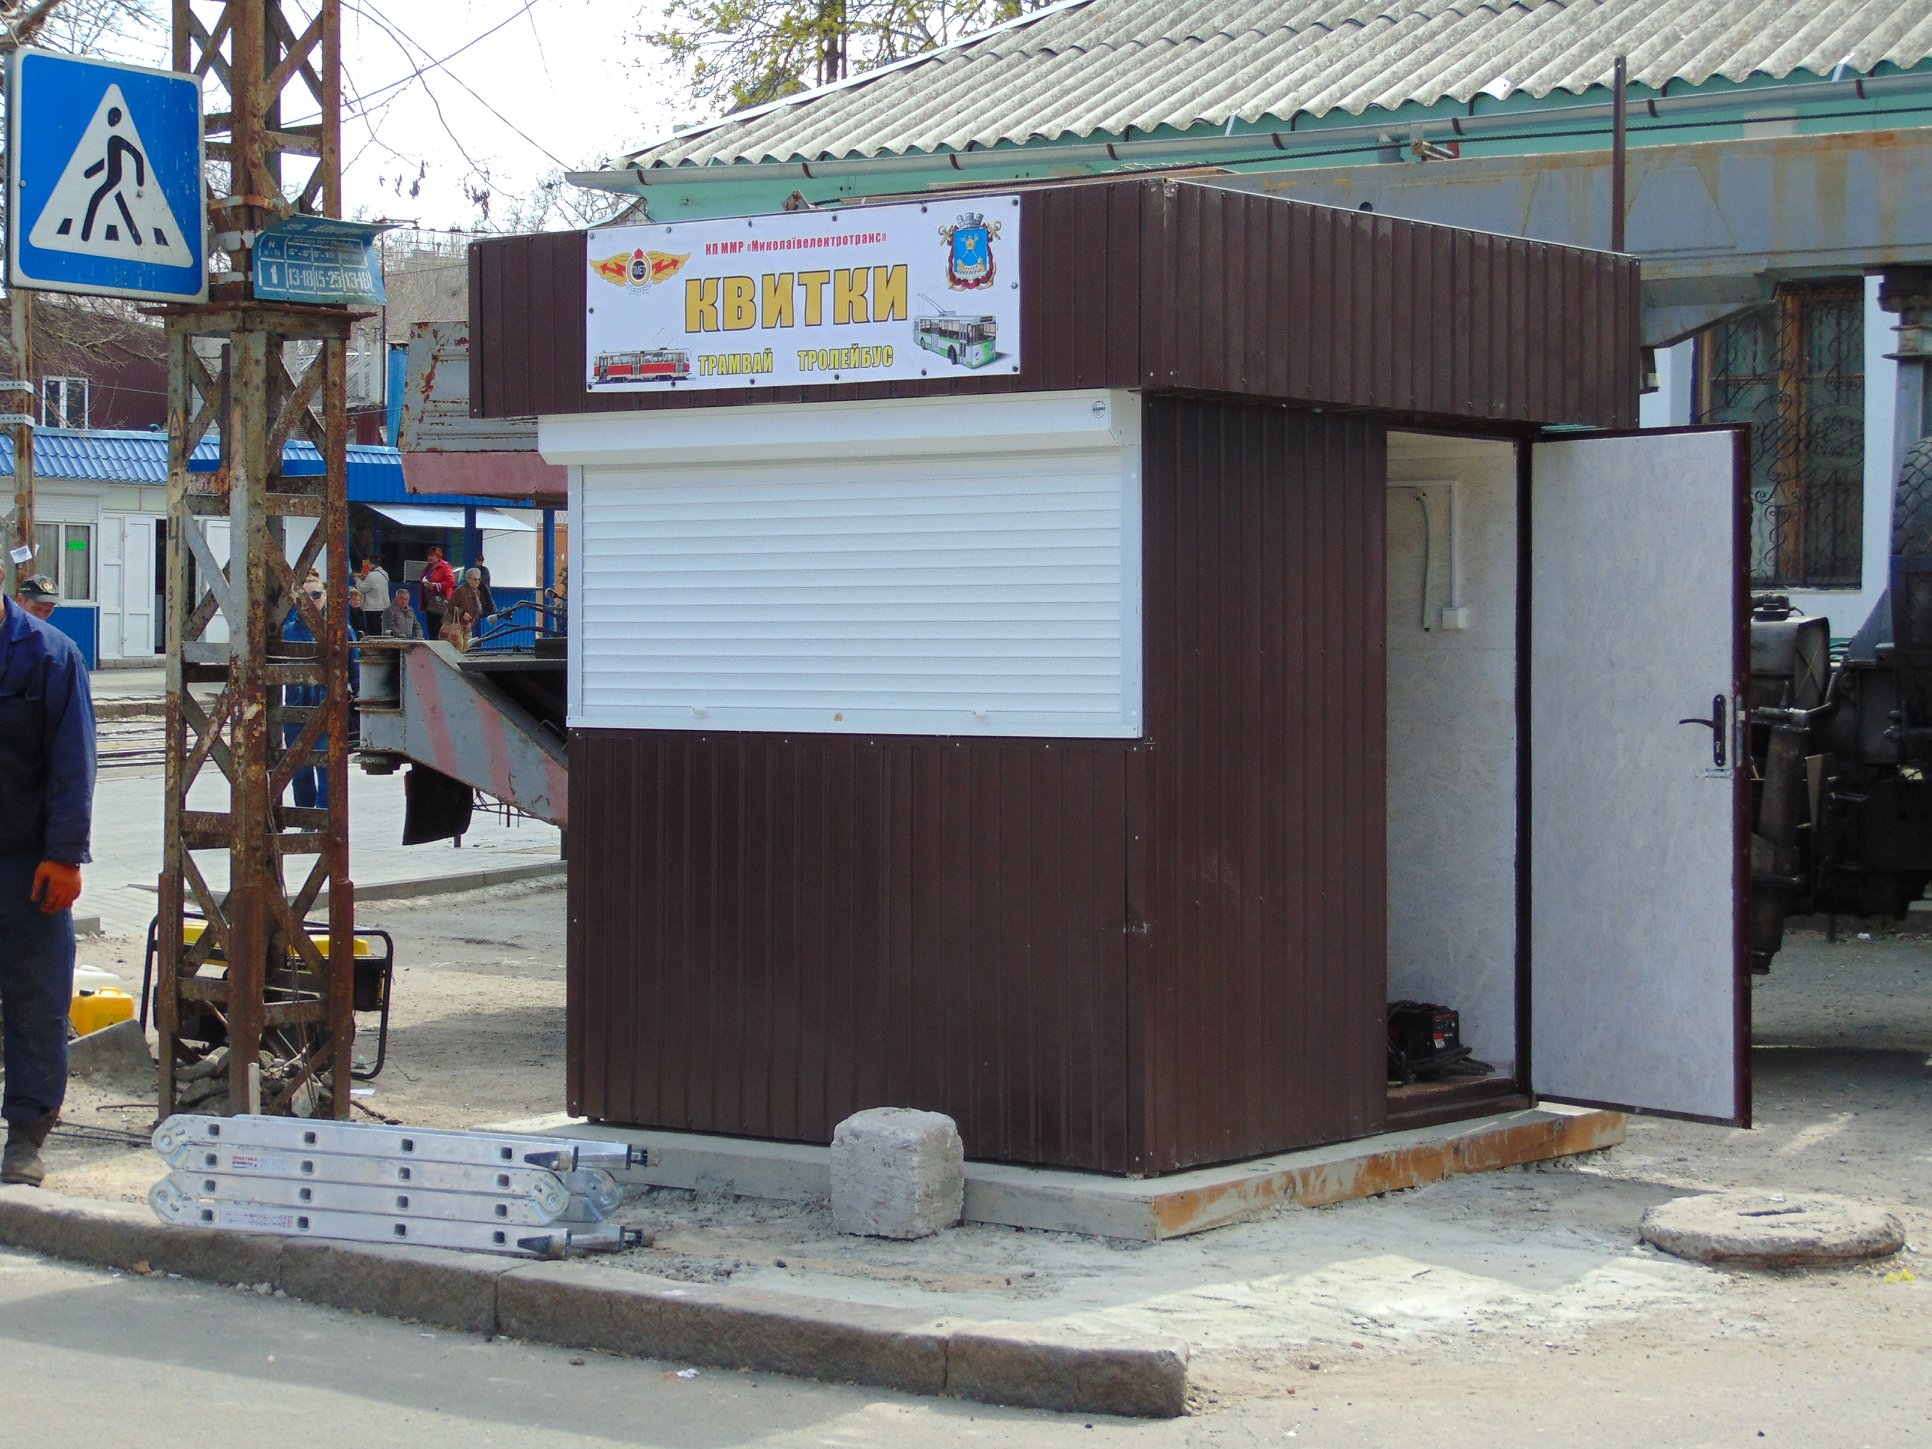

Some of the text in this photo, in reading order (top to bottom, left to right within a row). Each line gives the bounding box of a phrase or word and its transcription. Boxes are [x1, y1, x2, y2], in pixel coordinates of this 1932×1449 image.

[705, 232, 887, 256] КП ММР «Миколаївелектротранс»
[270, 264, 278, 284] 1
[288, 268, 314, 287] 13-18
[685, 263, 908, 334] КВИТКИ
[698, 343, 894, 376] ТРАМВАЙ ТРОЛЕЙБУС
